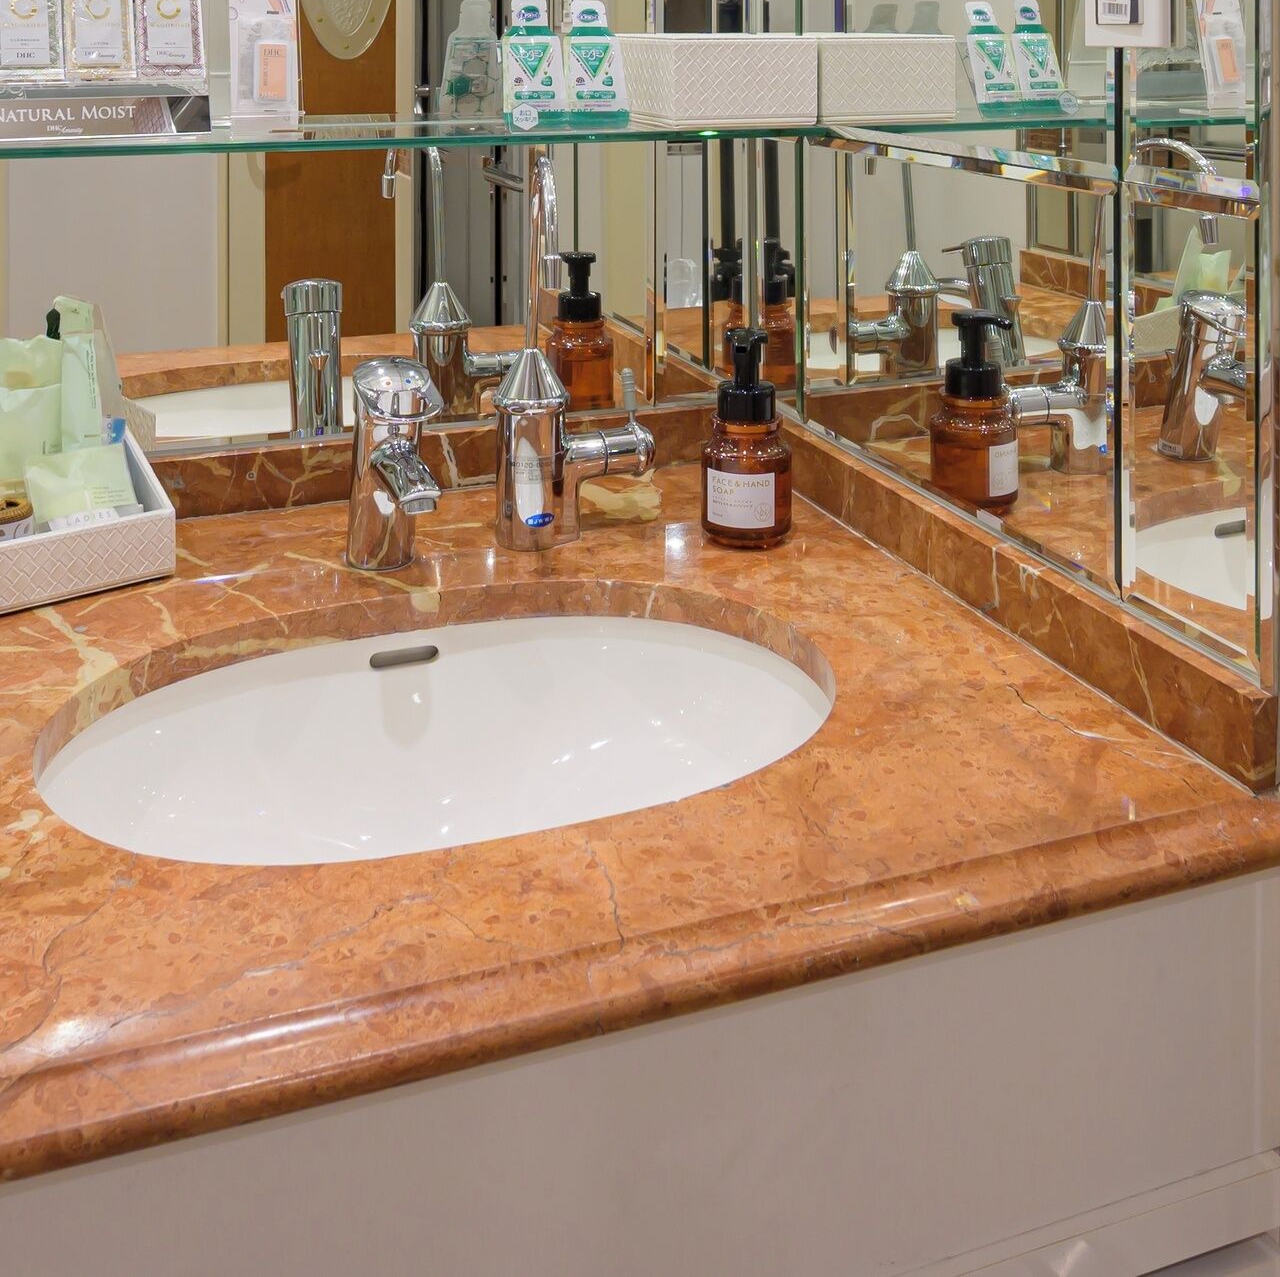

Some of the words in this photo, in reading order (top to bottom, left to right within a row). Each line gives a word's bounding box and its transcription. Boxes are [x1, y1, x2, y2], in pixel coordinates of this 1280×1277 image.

[263, 48, 282, 57] DHC
[81, 104, 136, 121] MOIST
[46, 124, 62, 132] DHC
[712, 476, 733, 487] FACE
[742, 479, 771, 488] HAND
[712, 485, 735, 496] SOAP
[65, 510, 112, 526] LADIES
